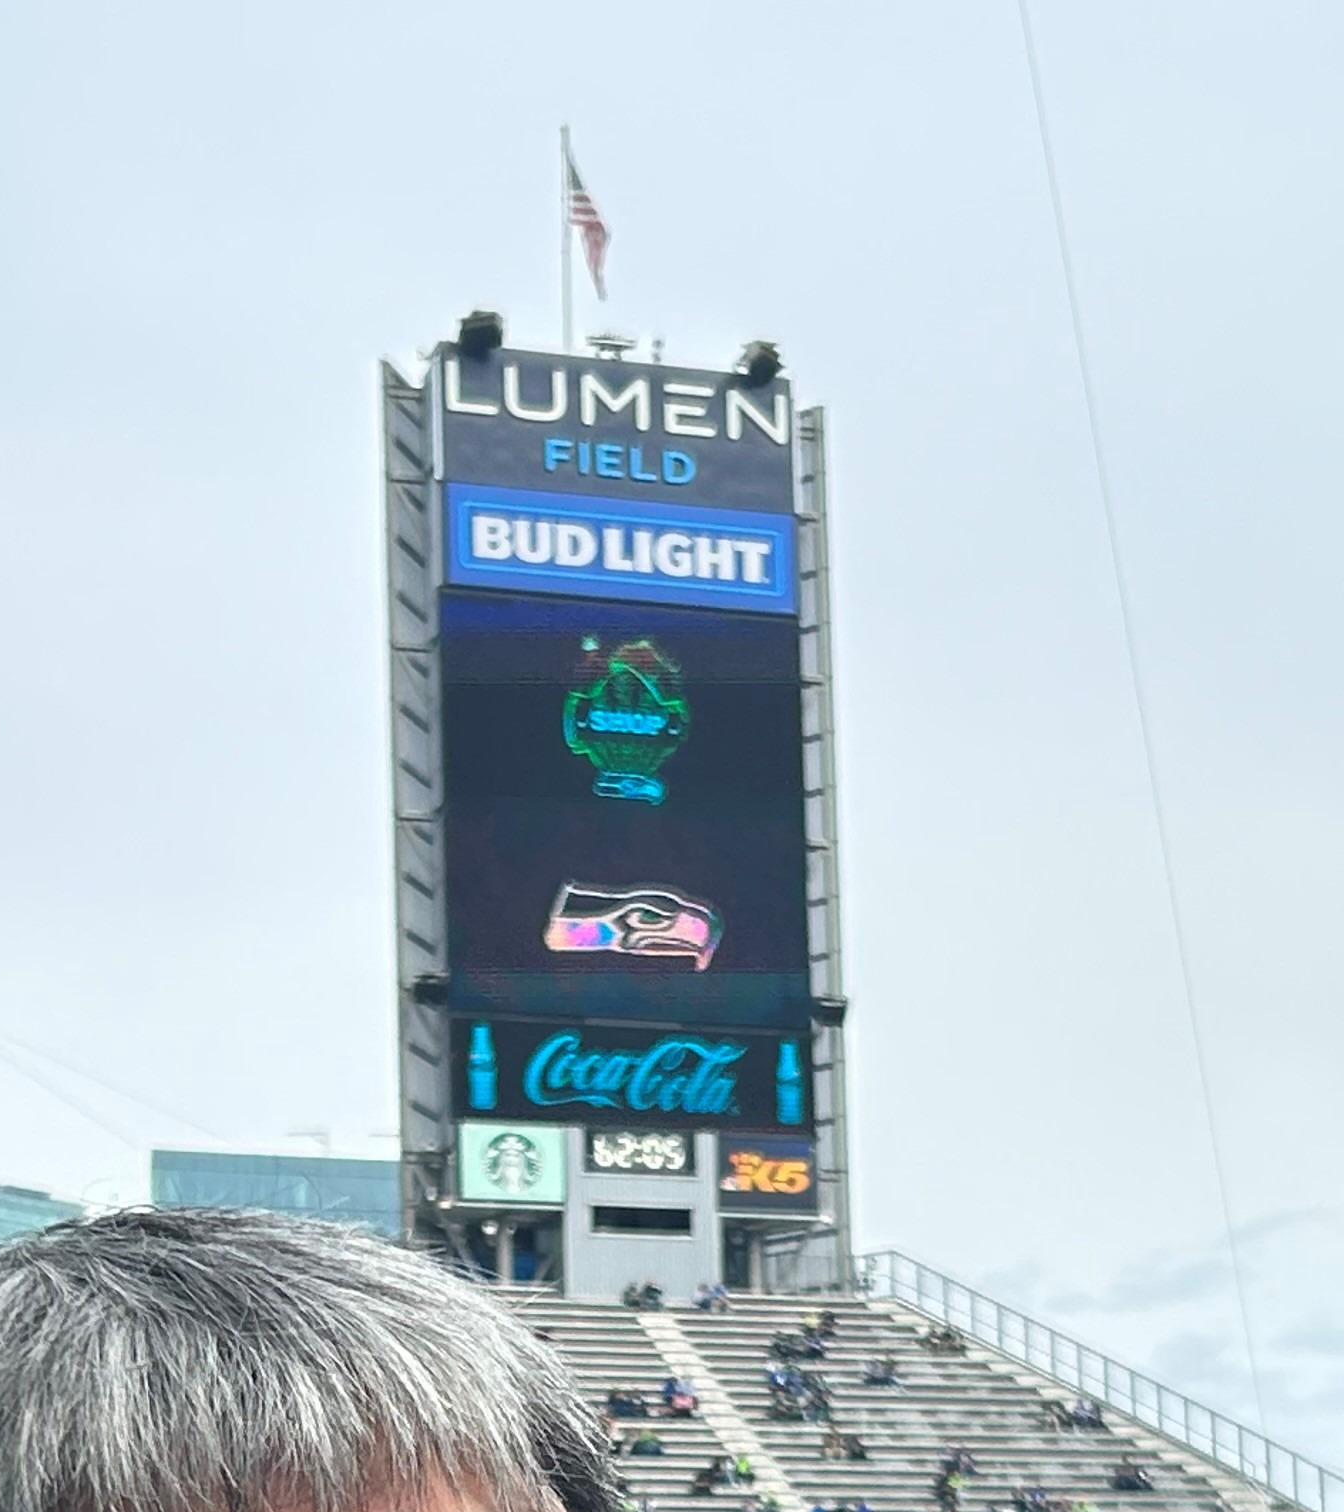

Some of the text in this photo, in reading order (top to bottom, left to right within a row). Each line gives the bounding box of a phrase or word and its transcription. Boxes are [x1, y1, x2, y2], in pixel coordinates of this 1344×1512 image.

[445, 360, 788, 445] LUMEN
[543, 437, 697, 486] FIELD
[471, 514, 771, 585] BUD LIGHT
